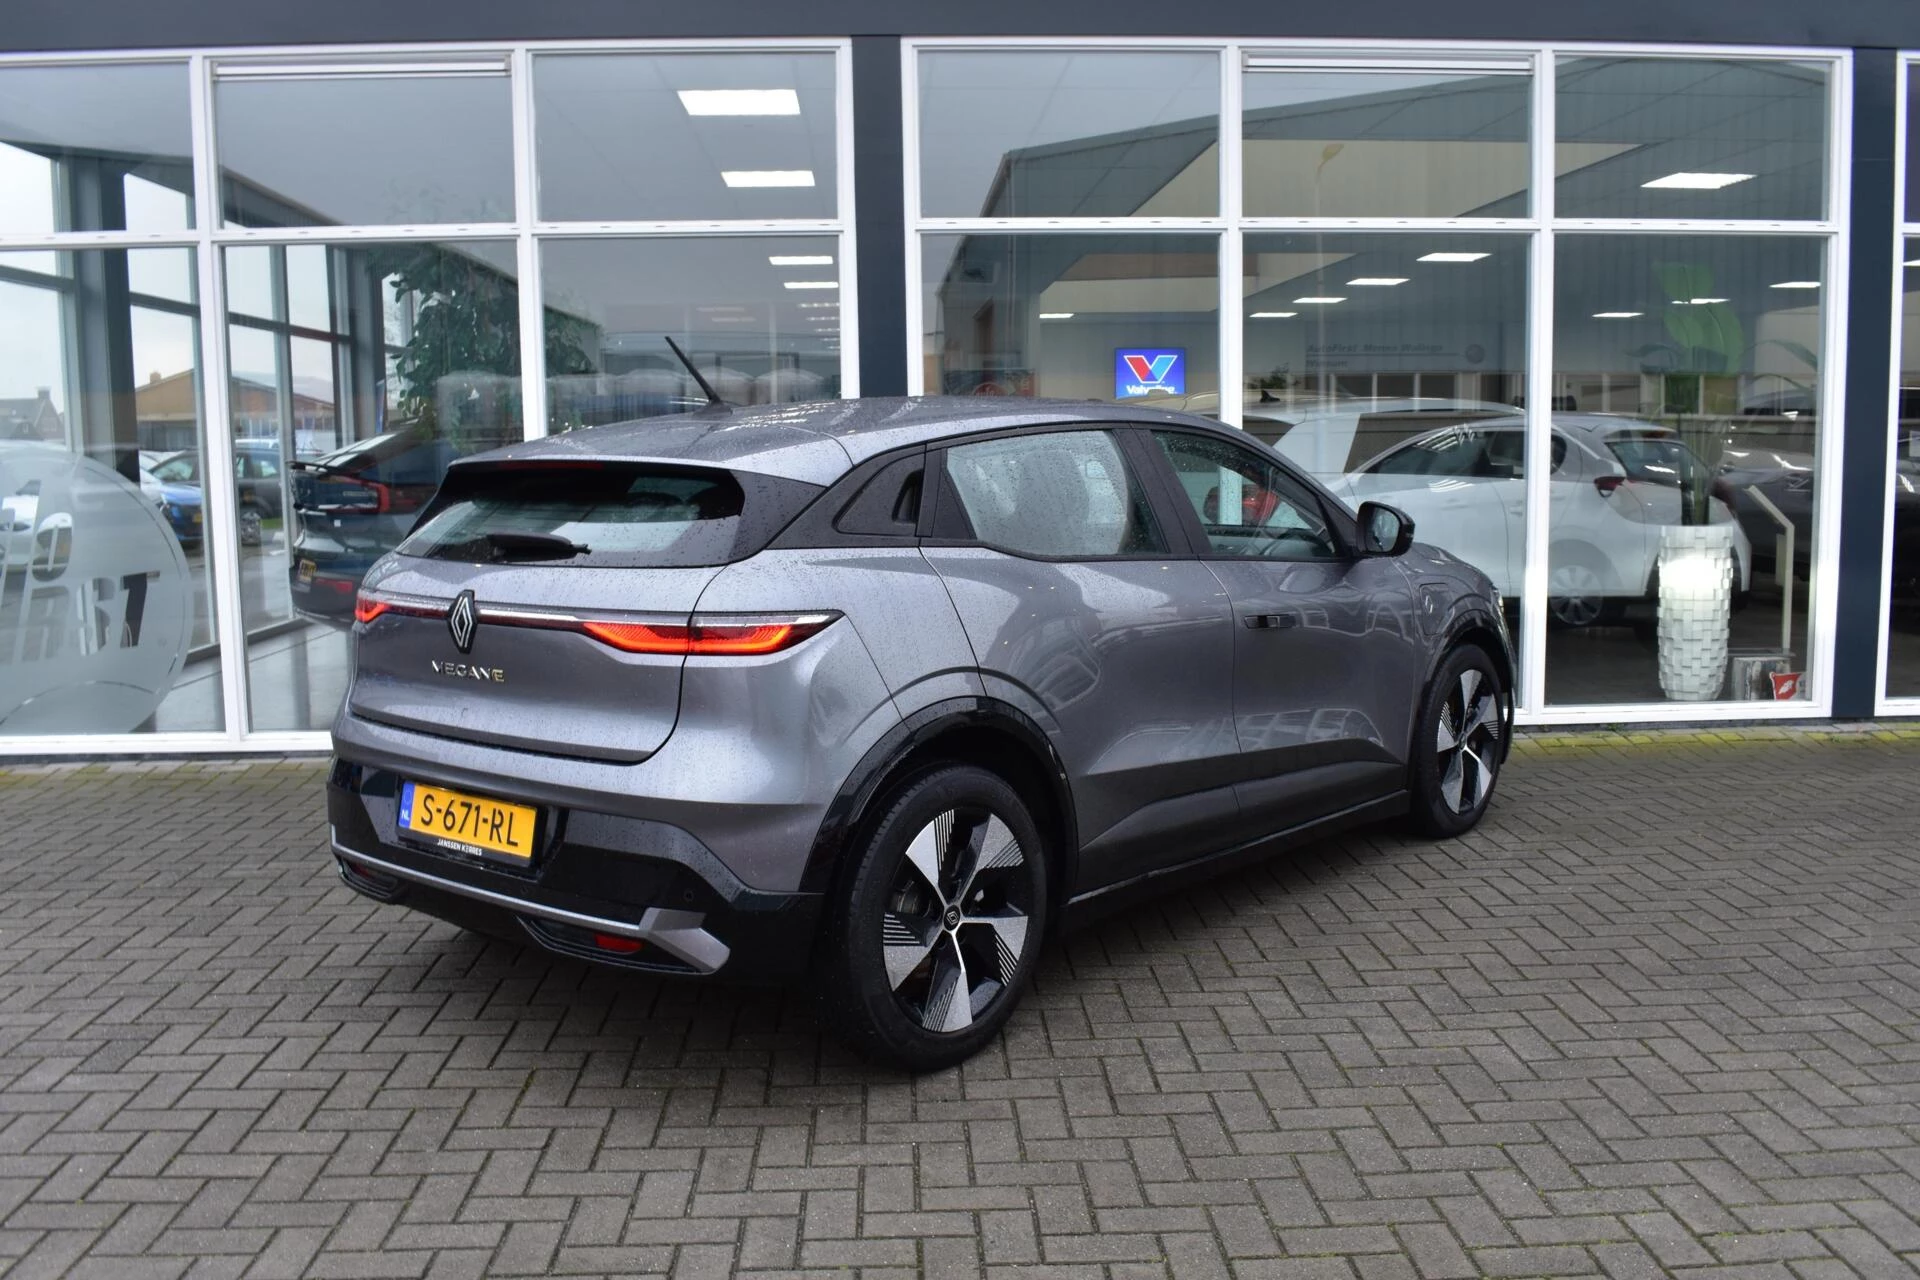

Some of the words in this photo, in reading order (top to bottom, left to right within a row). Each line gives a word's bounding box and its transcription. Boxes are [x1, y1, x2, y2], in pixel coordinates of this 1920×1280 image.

[432, 660, 504, 682] MEGANE
[401, 809, 410, 821] NL
[421, 794, 519, 847] S-671-RL
[437, 838, 461, 851] JANSSEN
